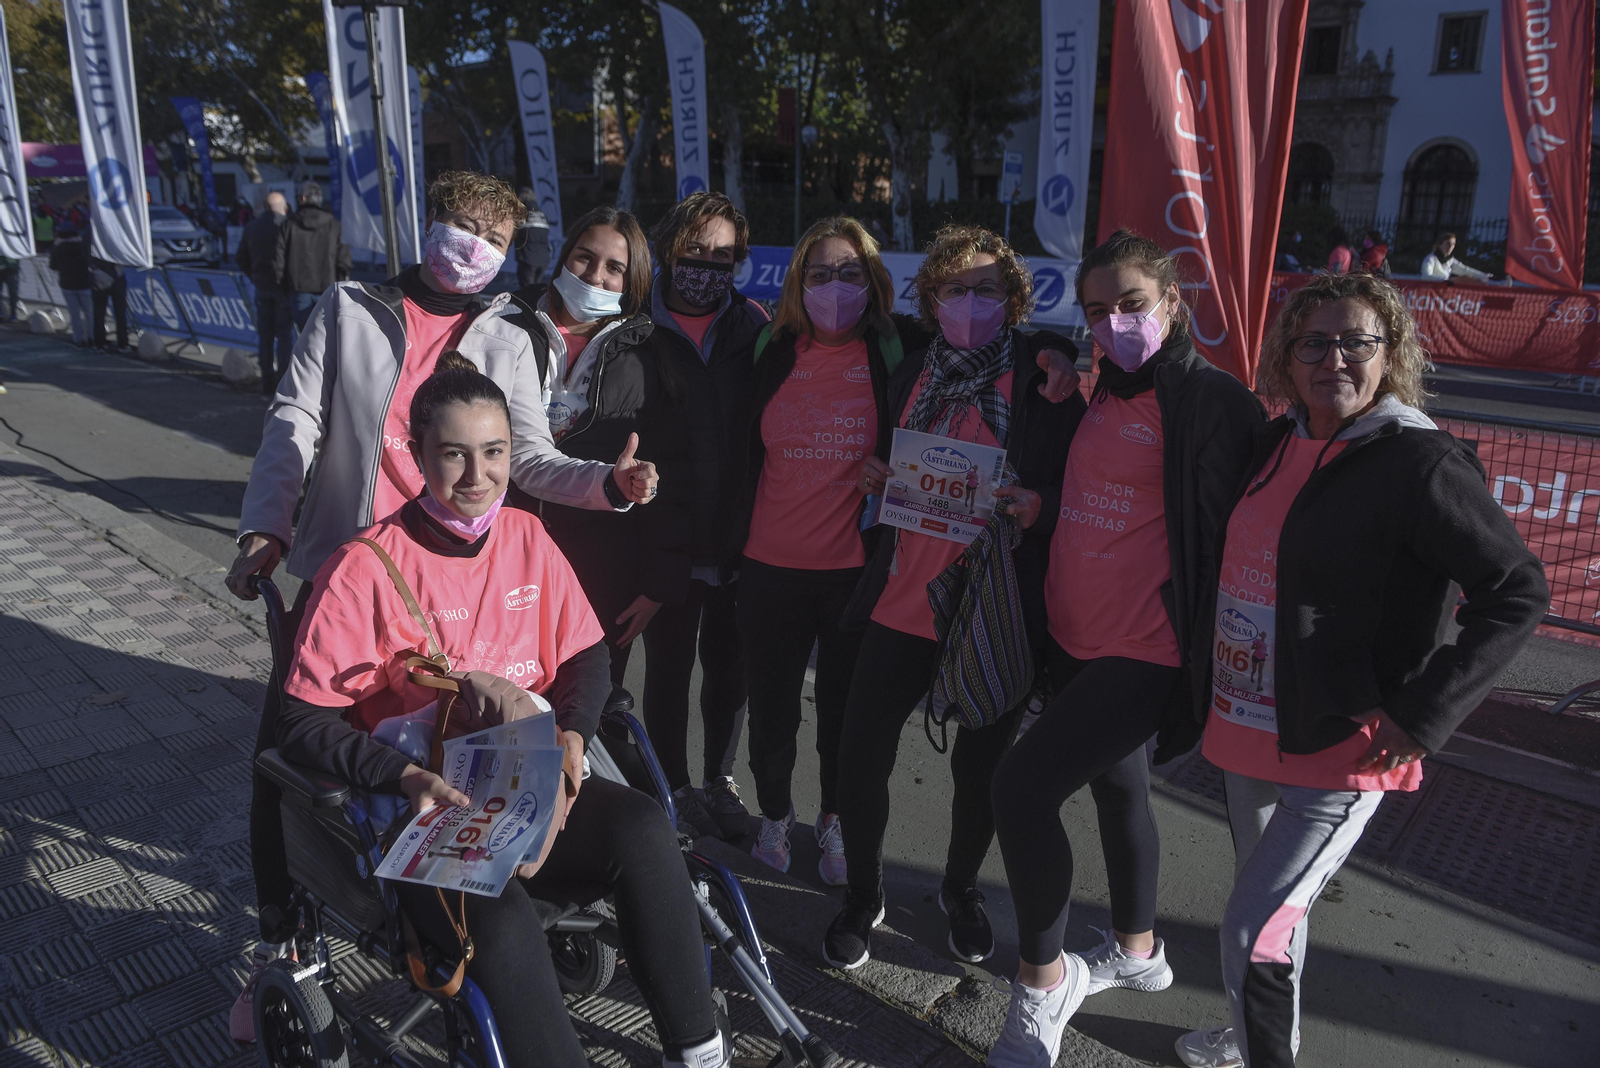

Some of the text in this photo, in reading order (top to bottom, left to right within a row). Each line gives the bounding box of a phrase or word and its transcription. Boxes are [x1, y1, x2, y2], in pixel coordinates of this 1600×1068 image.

[834, 417, 866, 429] POR
[813, 432, 865, 445] TODAS
[783, 448, 864, 461] NOSOTRAS
[925, 454, 968, 470] ASTURIANA
[920, 474, 965, 499] 016
[1104, 482, 1135, 498] POR
[904, 501, 973, 523] CARRERA DE LA MUJER
[927, 497, 950, 510] 1488
[1083, 492, 1131, 513] TODAS
[885, 510, 918, 525] OYSHO
[1216, 640, 1250, 672] 016
[506, 659, 537, 679] POR
[1233, 690, 1261, 702] MUJER
[1247, 711, 1275, 722] ZURICH
[448, 808, 476, 828] 2118
[456, 796, 506, 844] 016
[490, 797, 534, 849] ASTURIANA
[416, 829, 440, 856] MUJER
[390, 842, 411, 870] ZURICH
